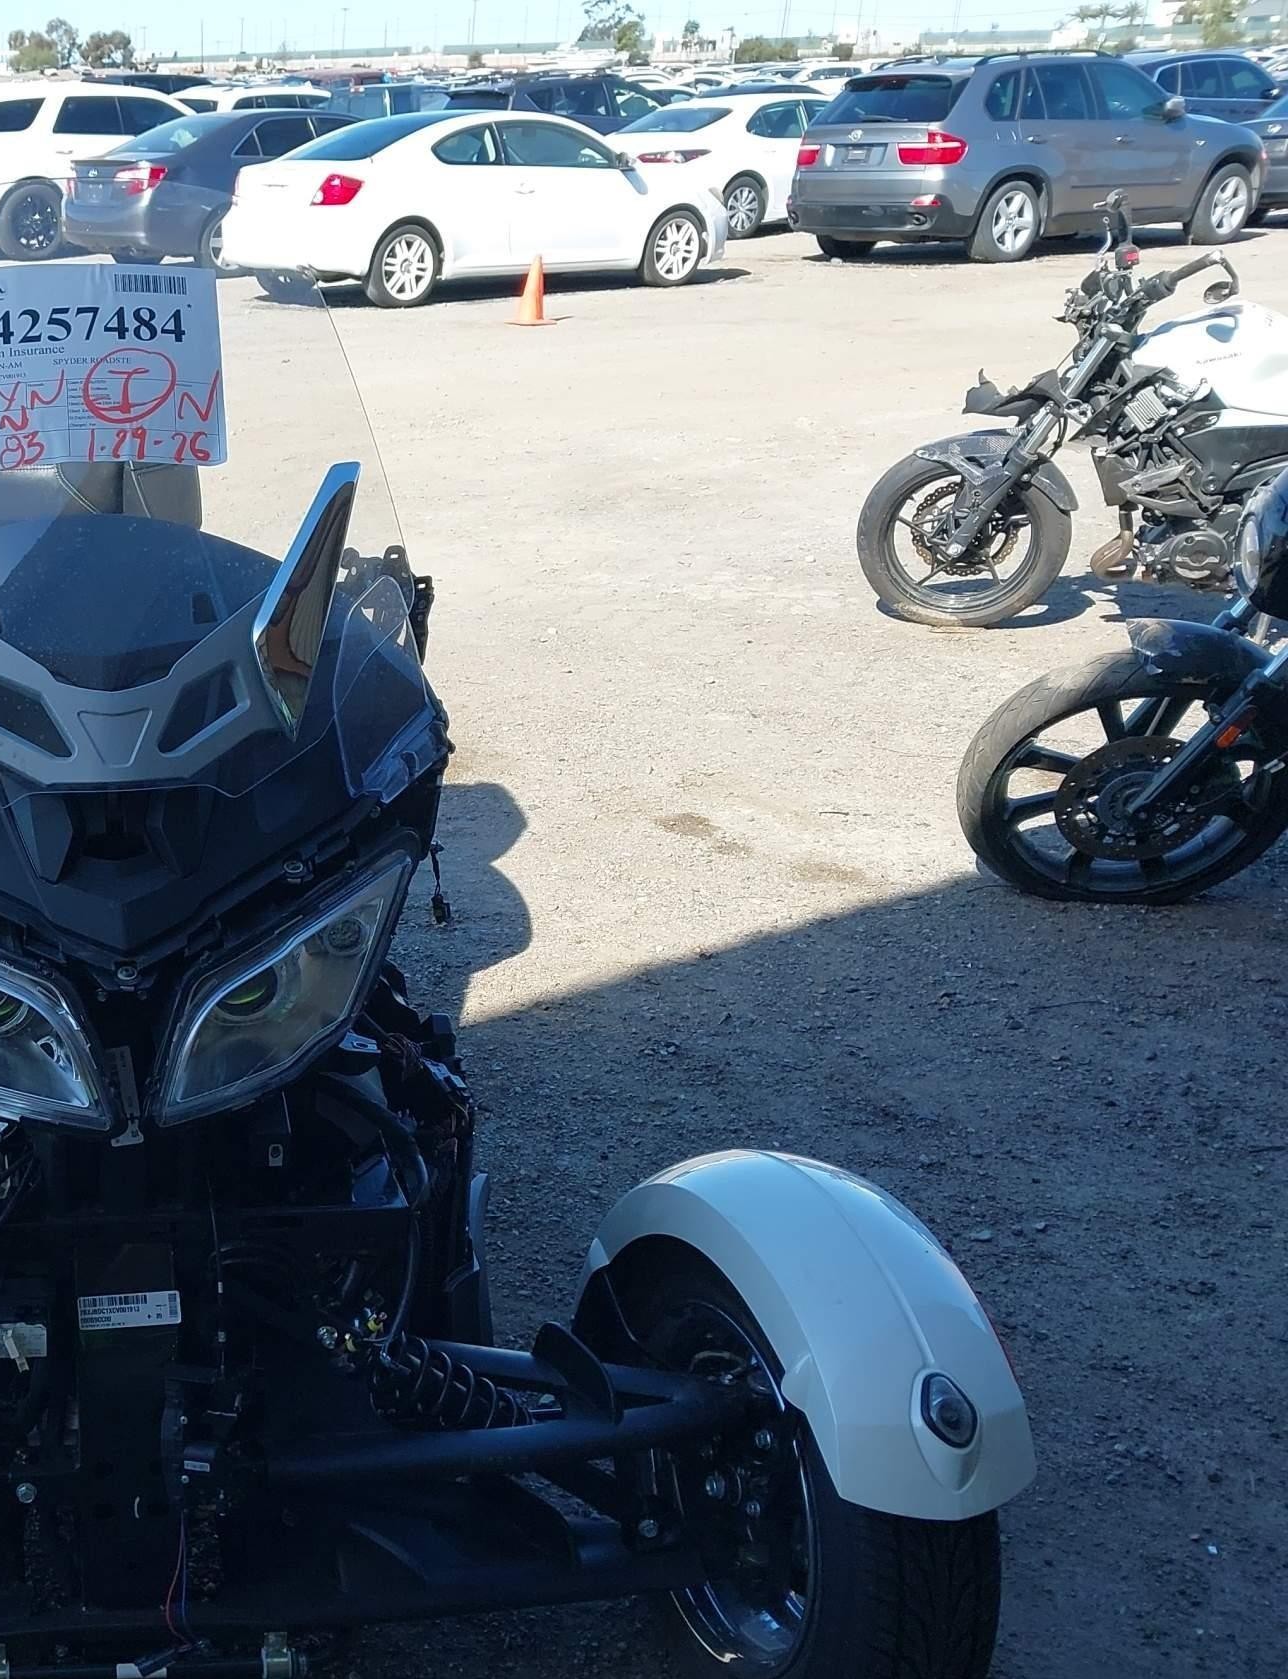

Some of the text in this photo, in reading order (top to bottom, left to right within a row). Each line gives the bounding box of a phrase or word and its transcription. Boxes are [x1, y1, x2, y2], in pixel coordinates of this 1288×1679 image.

[9, 345, 65, 358] Insurance
[52, 357, 88, 366] SPYDER
[90, 356, 131, 365] ROADSTE
